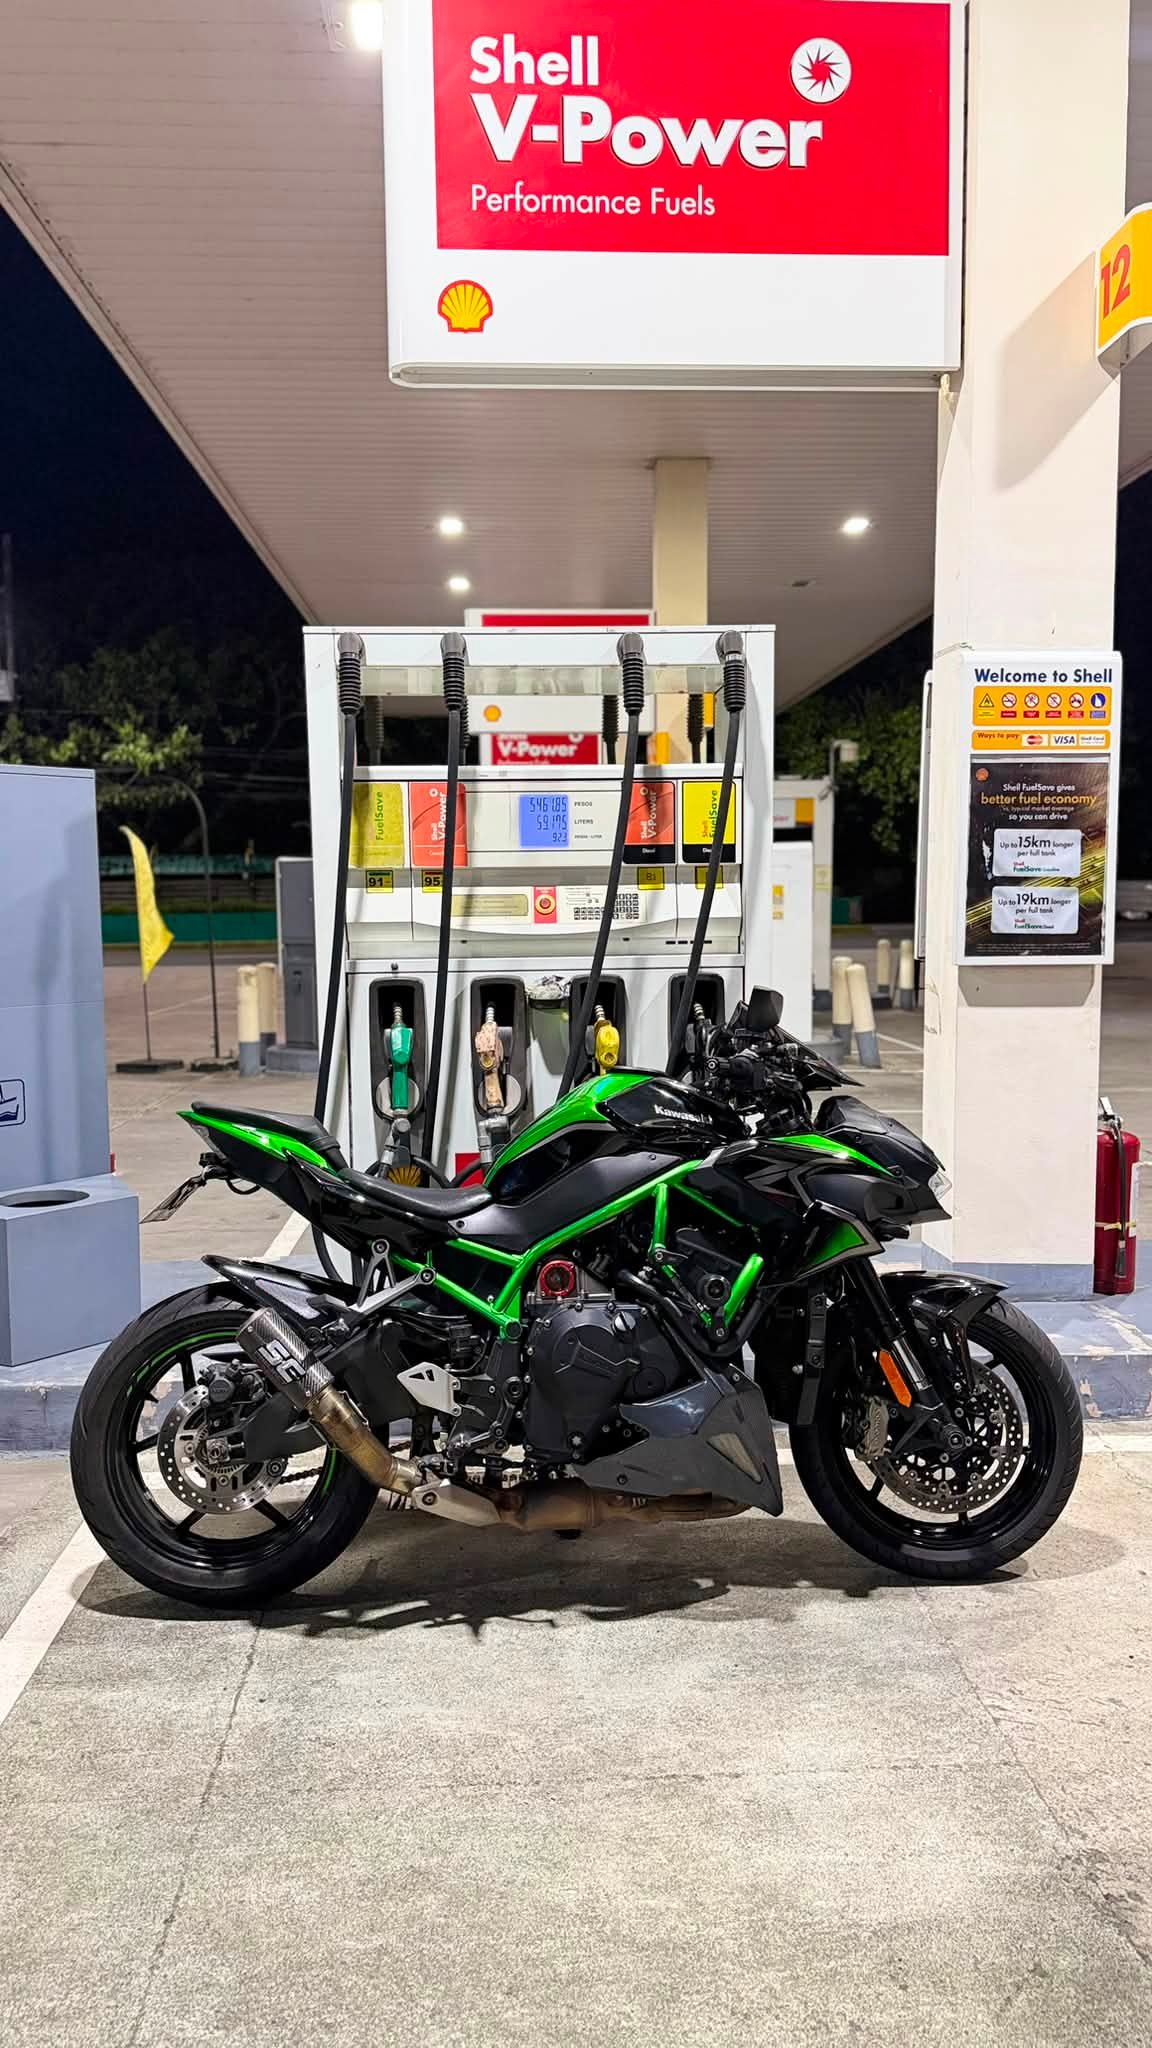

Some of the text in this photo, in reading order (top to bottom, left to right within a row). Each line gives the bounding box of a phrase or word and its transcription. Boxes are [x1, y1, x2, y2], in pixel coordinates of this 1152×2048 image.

[470, 34, 599, 86] Shell
[470, 93, 823, 168] V-Power
[471, 181, 715, 216] Performance Fuels
[1101, 244, 1130, 320] 12
[975, 668, 1112, 683] Welcome to Shell
[977, 732, 995, 740] Ways
[1053, 736, 1075, 744] VISA
[497, 741, 578, 757] V-Power
[1002, 783, 1075, 792] Shell FuelSave gives
[981, 792, 1097, 806] better fuel economy
[375, 792, 384, 840] FuelSave
[438, 792, 447, 840] V-Power
[648, 791, 657, 838] V-Power
[1018, 835, 1051, 848] 15km
[368, 877, 384, 887] 91
[424, 877, 440, 887] 95
[1016, 892, 1049, 905] 19km
